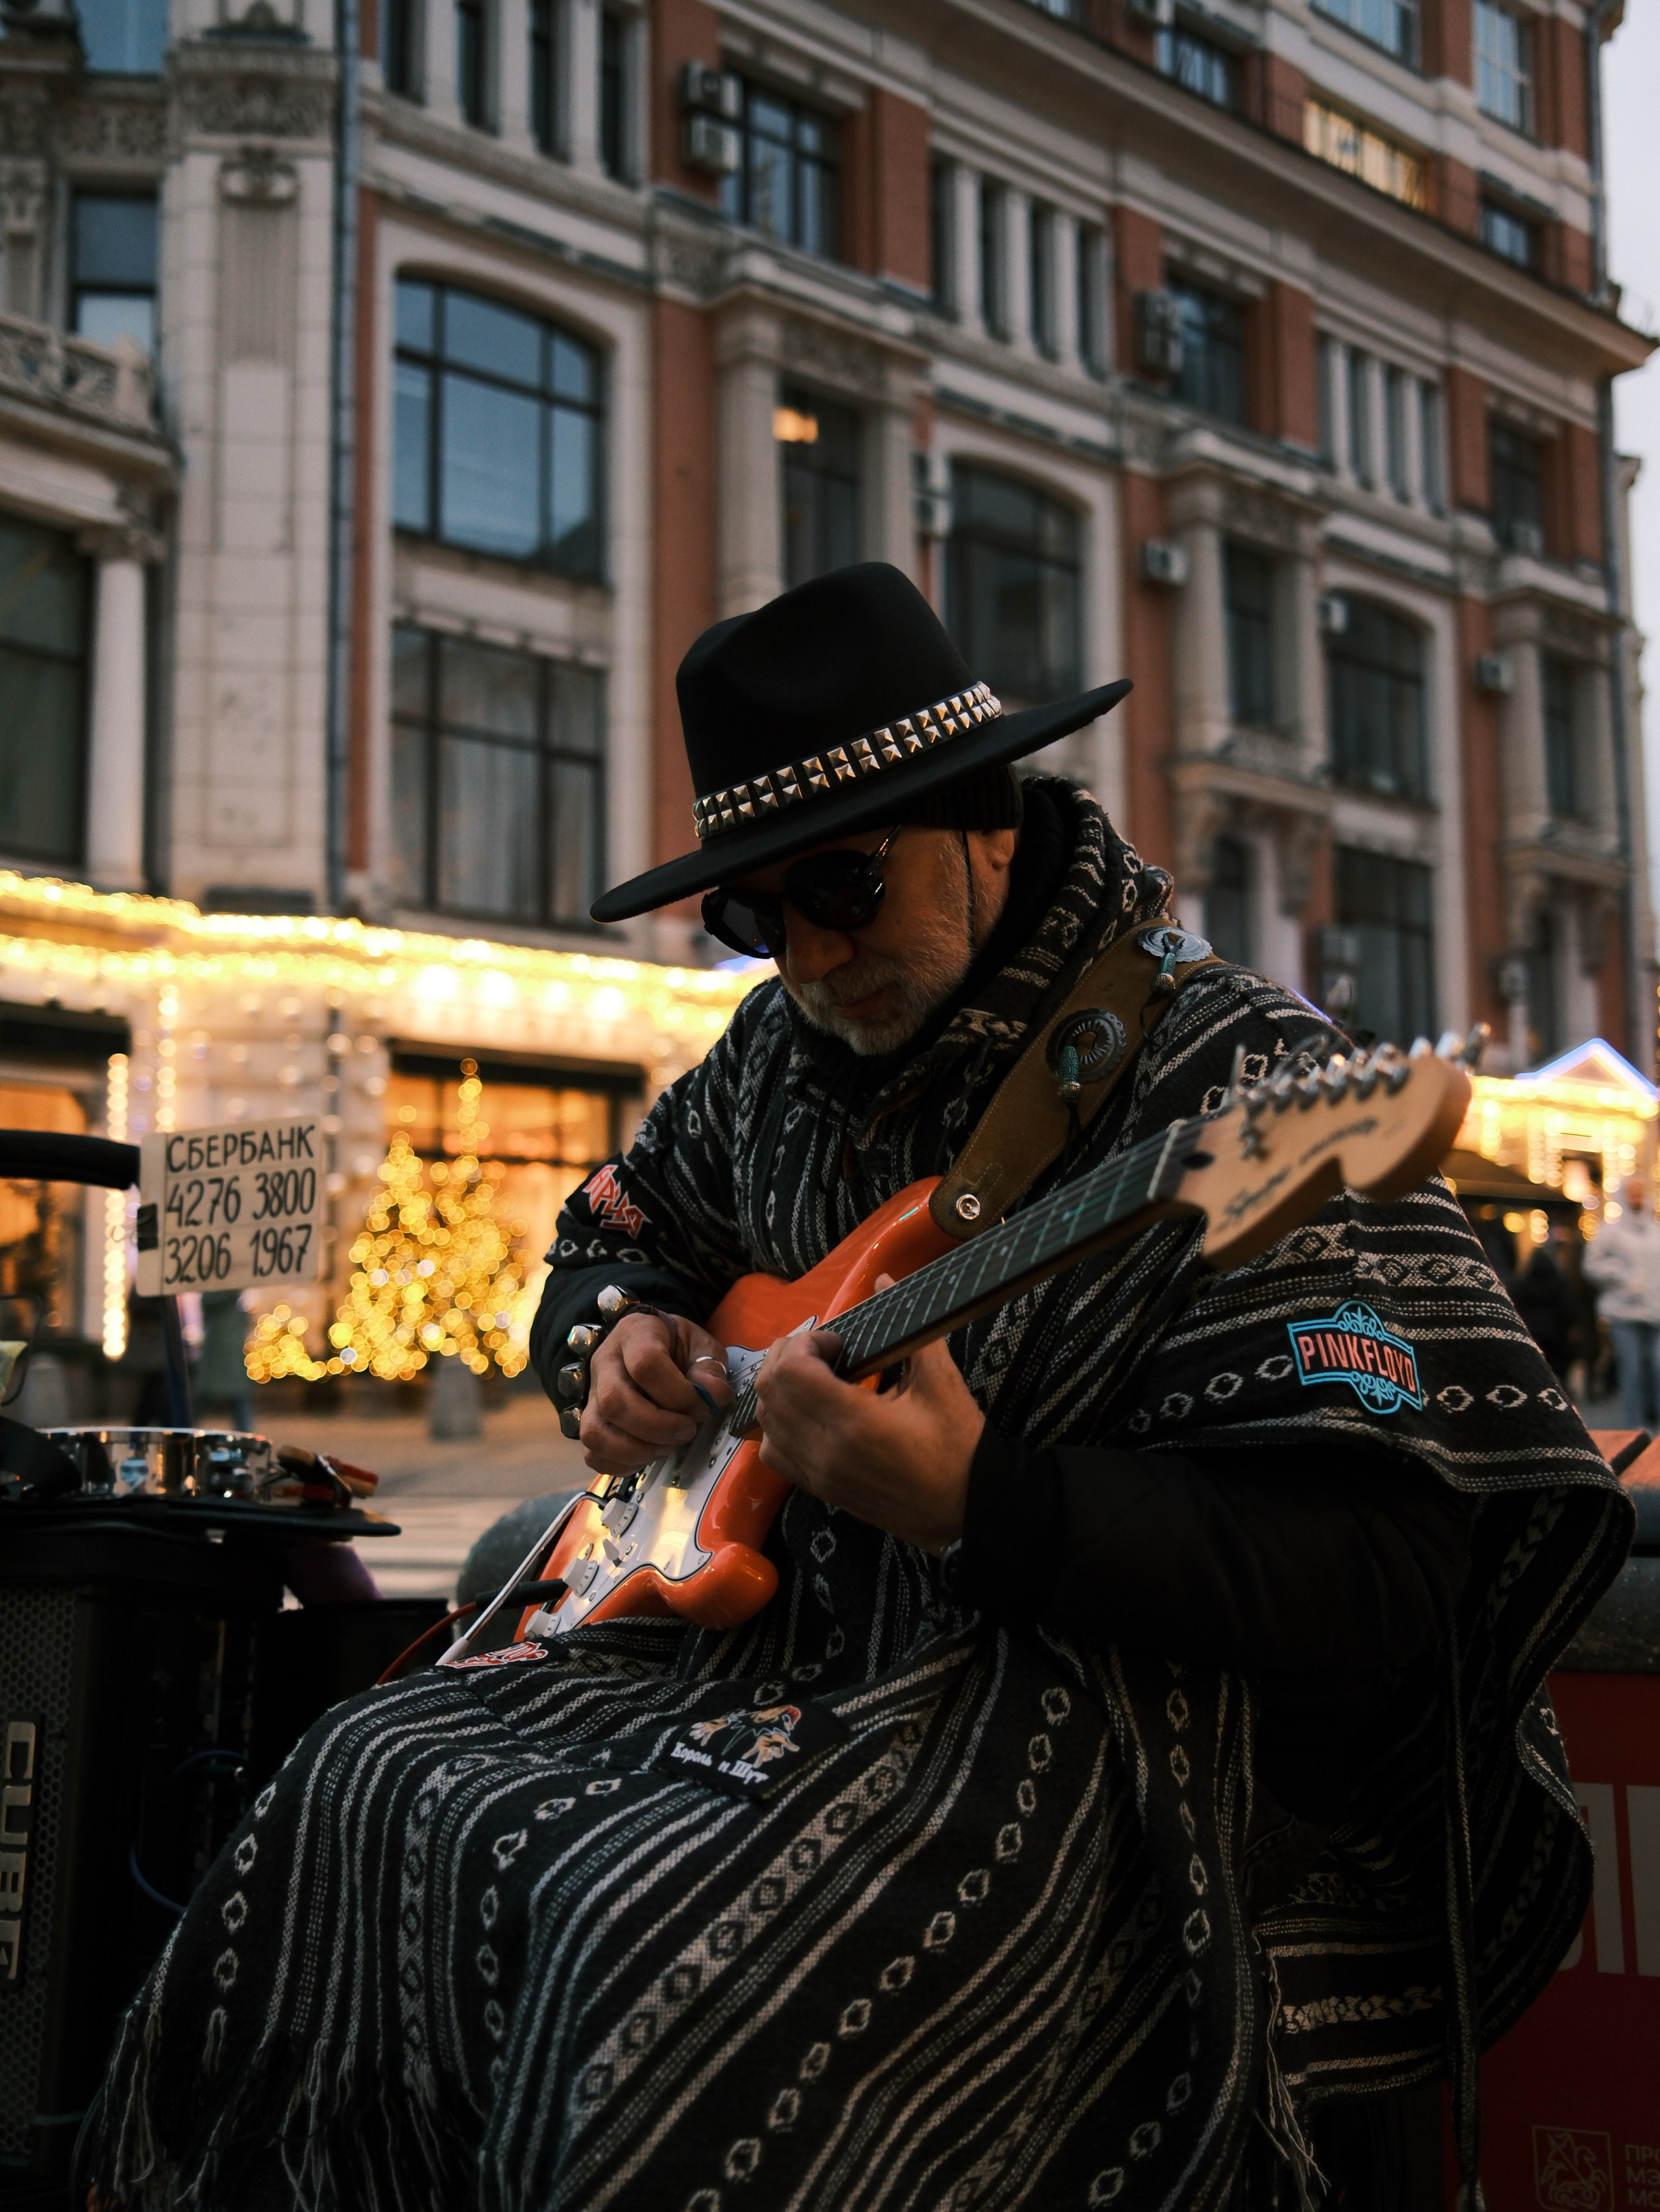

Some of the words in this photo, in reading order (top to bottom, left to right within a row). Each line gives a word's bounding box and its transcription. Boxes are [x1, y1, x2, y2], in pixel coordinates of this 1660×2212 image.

[167, 1125, 315, 1172] СБЕРБАНК
[166, 1176, 241, 1227] 4276
[252, 1167, 316, 1220] 3800
[165, 1233, 231, 1284] 3206
[249, 1224, 312, 1278] 1967
